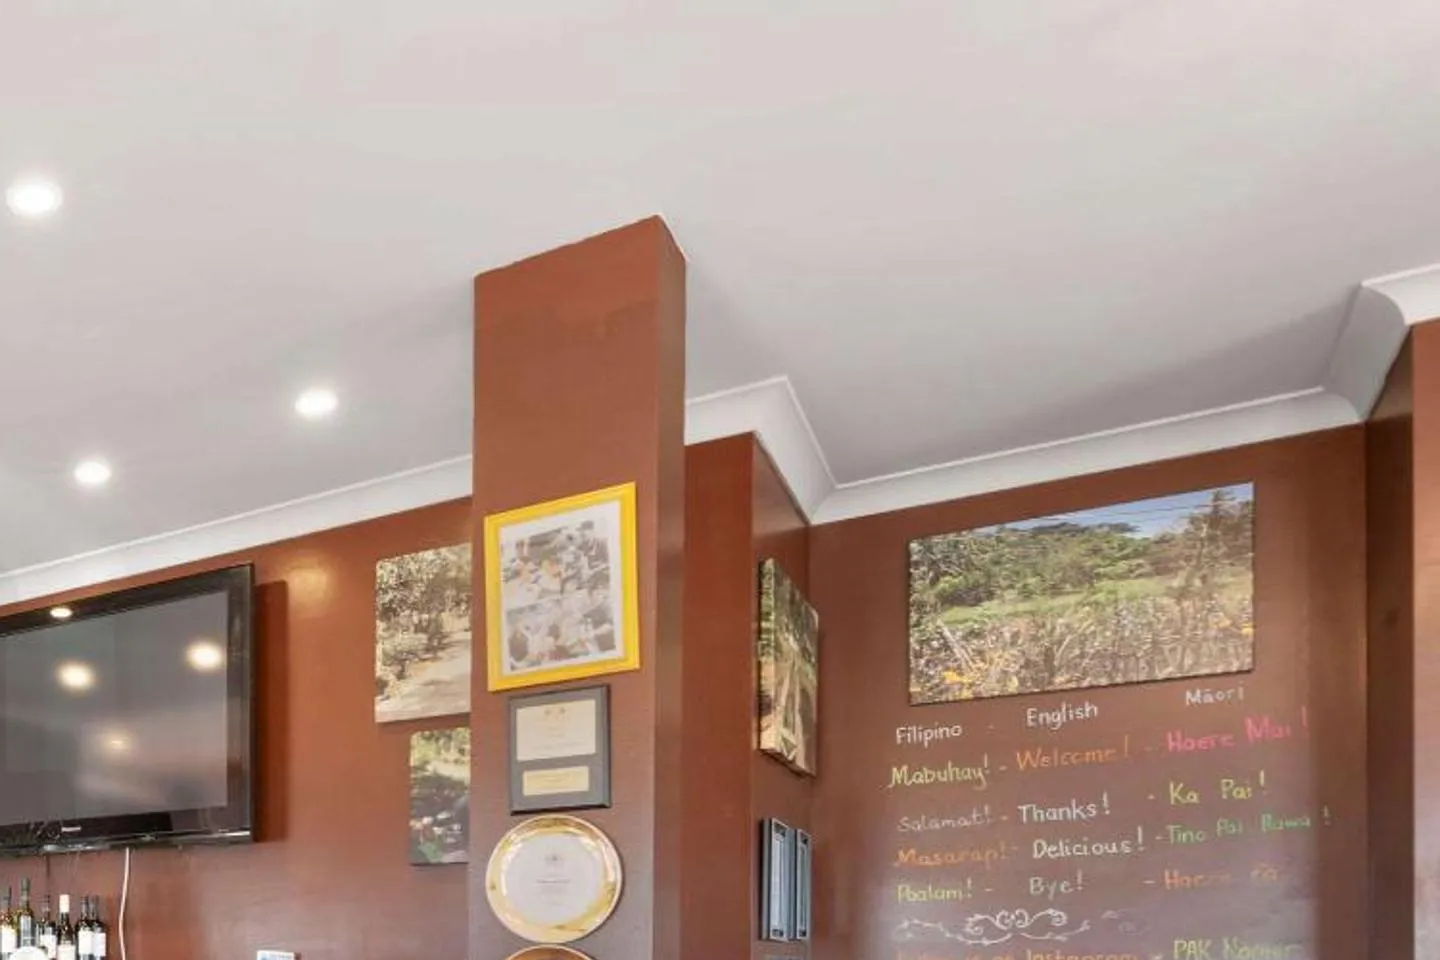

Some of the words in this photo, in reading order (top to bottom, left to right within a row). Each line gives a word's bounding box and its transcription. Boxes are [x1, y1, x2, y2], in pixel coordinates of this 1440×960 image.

[895, 724, 962, 748] Filipino
[1027, 702, 1098, 729] English
[1016, 735, 1130, 771] Welcome!
[1017, 791, 1110, 824] Thanks!
[1169, 781, 1199, 805] Ka
[1032, 826, 1145, 860] Delicious!
[1029, 870, 1084, 900] Bye!
